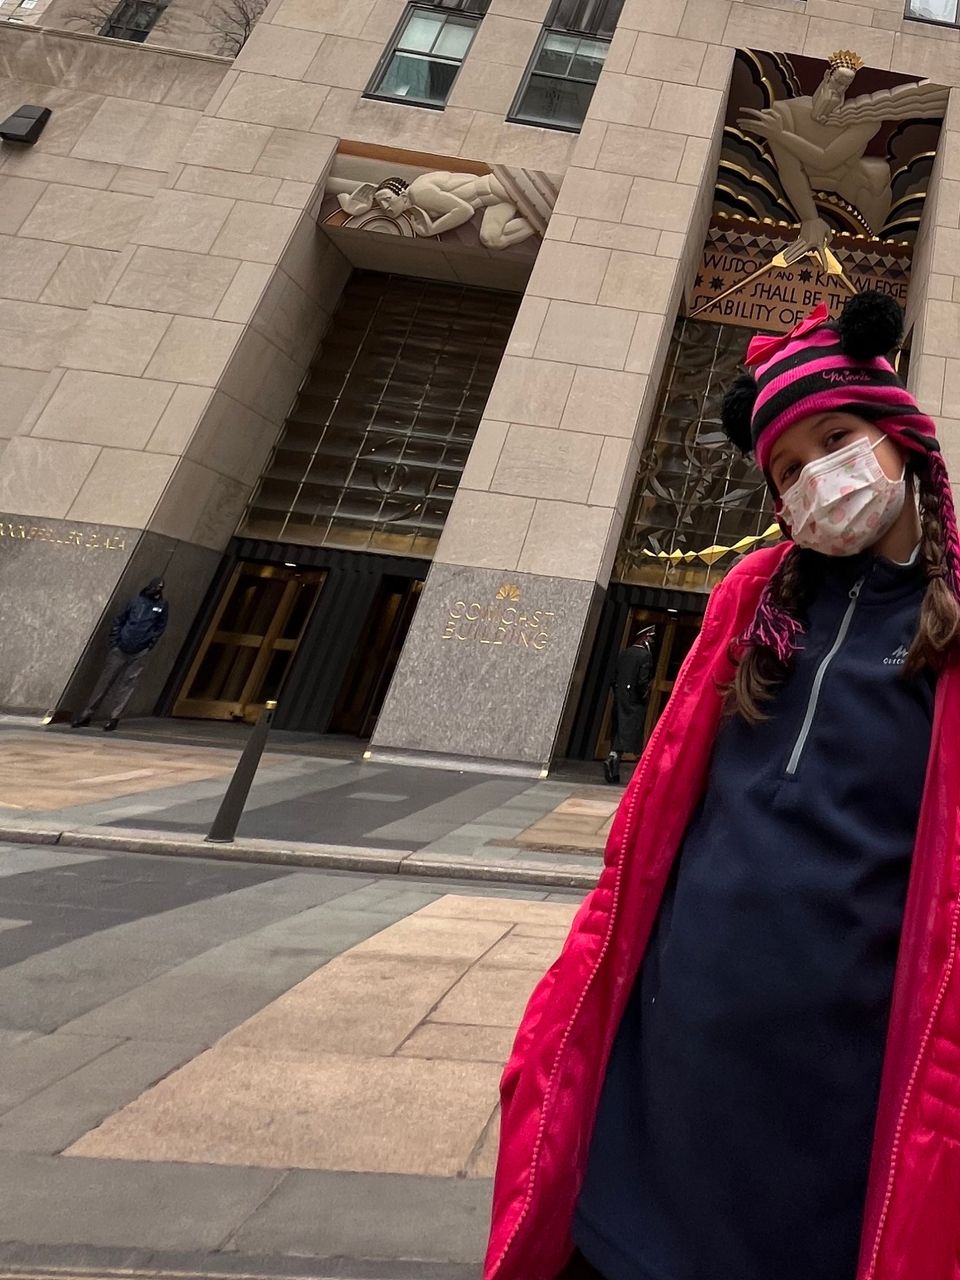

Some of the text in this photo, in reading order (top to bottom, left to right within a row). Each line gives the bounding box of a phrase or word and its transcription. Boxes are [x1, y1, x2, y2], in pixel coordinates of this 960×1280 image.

[775, 271, 794, 281] AND
[750, 282, 798, 304] SHALL
[802, 289, 823, 307] BE
[689, 294, 777, 322] STABILITY
[778, 308, 805, 326] OF
[822, 369, 872, 384] Minnie
[448, 600, 555, 629] COMCAST
[442, 621, 549, 650] BUILDING
